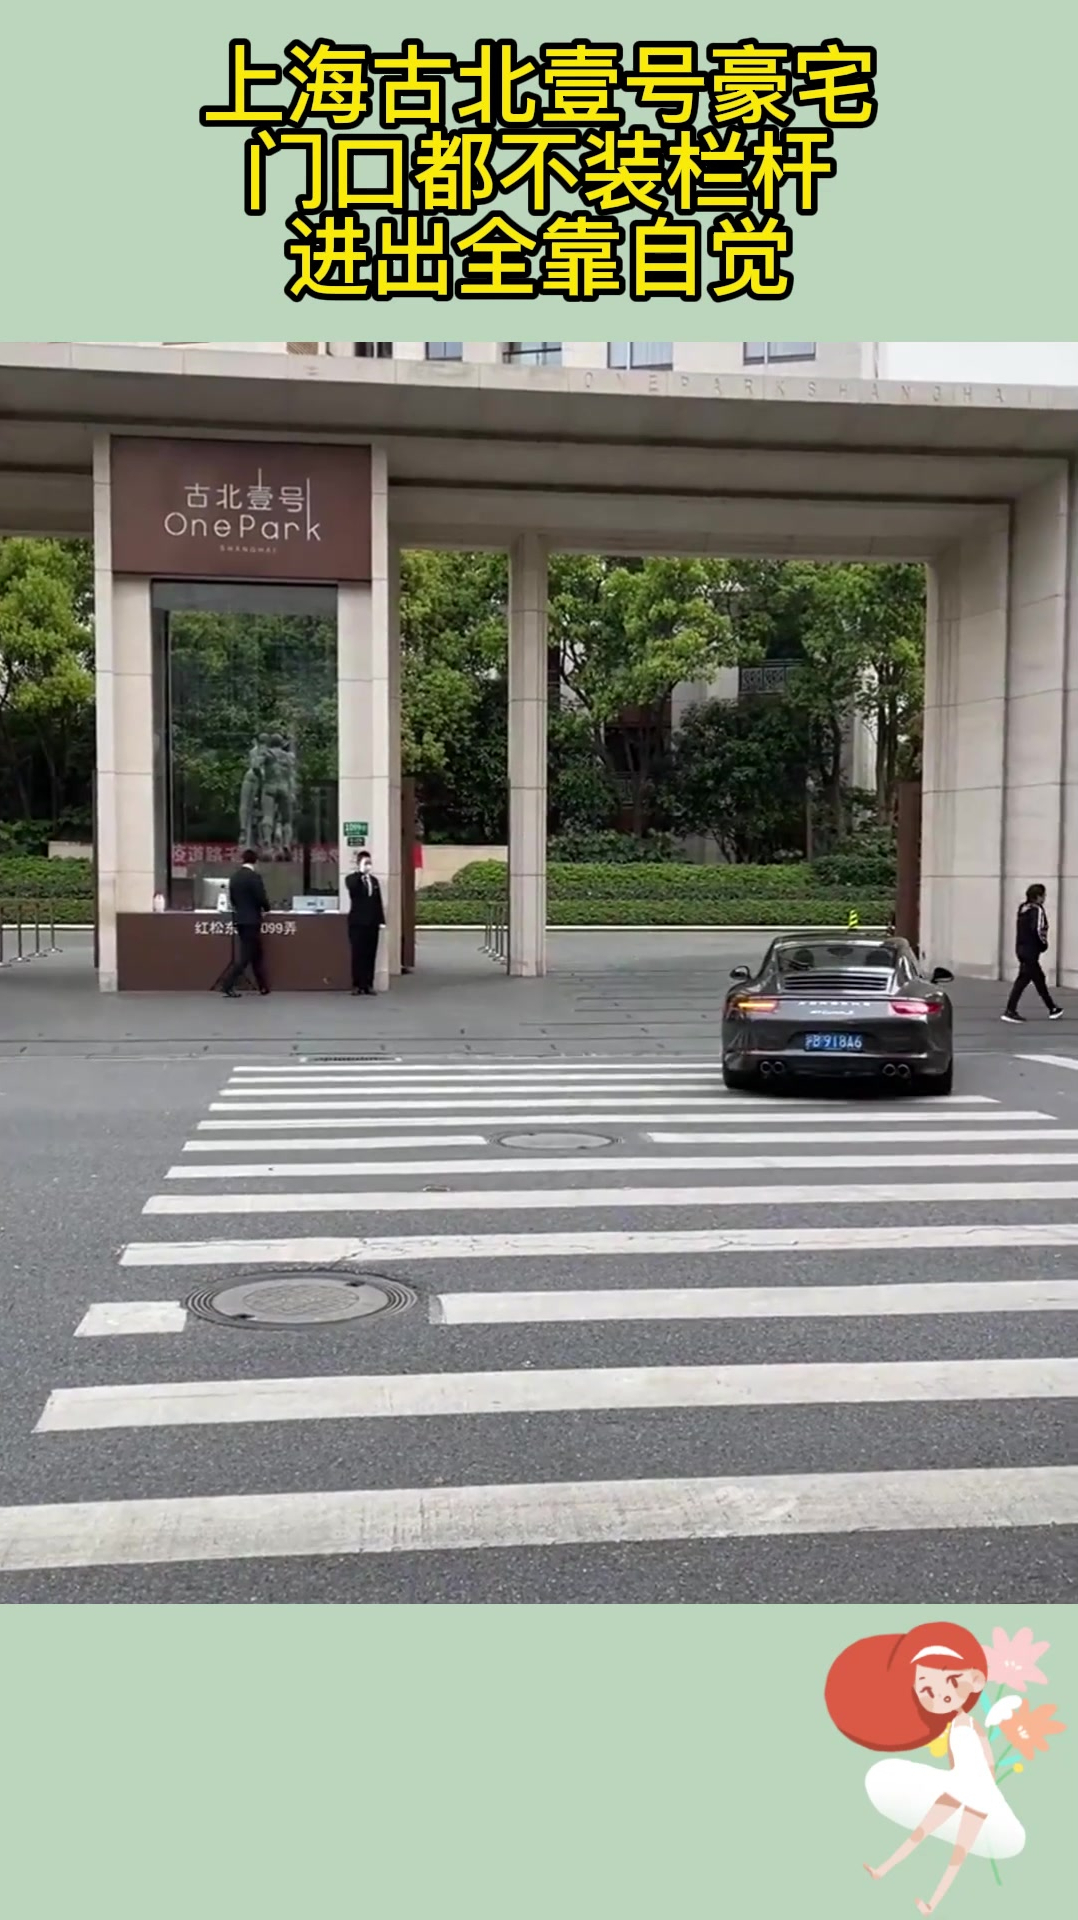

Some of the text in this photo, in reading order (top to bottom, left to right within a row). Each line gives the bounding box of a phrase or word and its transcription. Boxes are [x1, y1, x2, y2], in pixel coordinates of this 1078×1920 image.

[184, 468, 304, 513] 古北壹号
[219, 544, 278, 555] SHANGHAI
